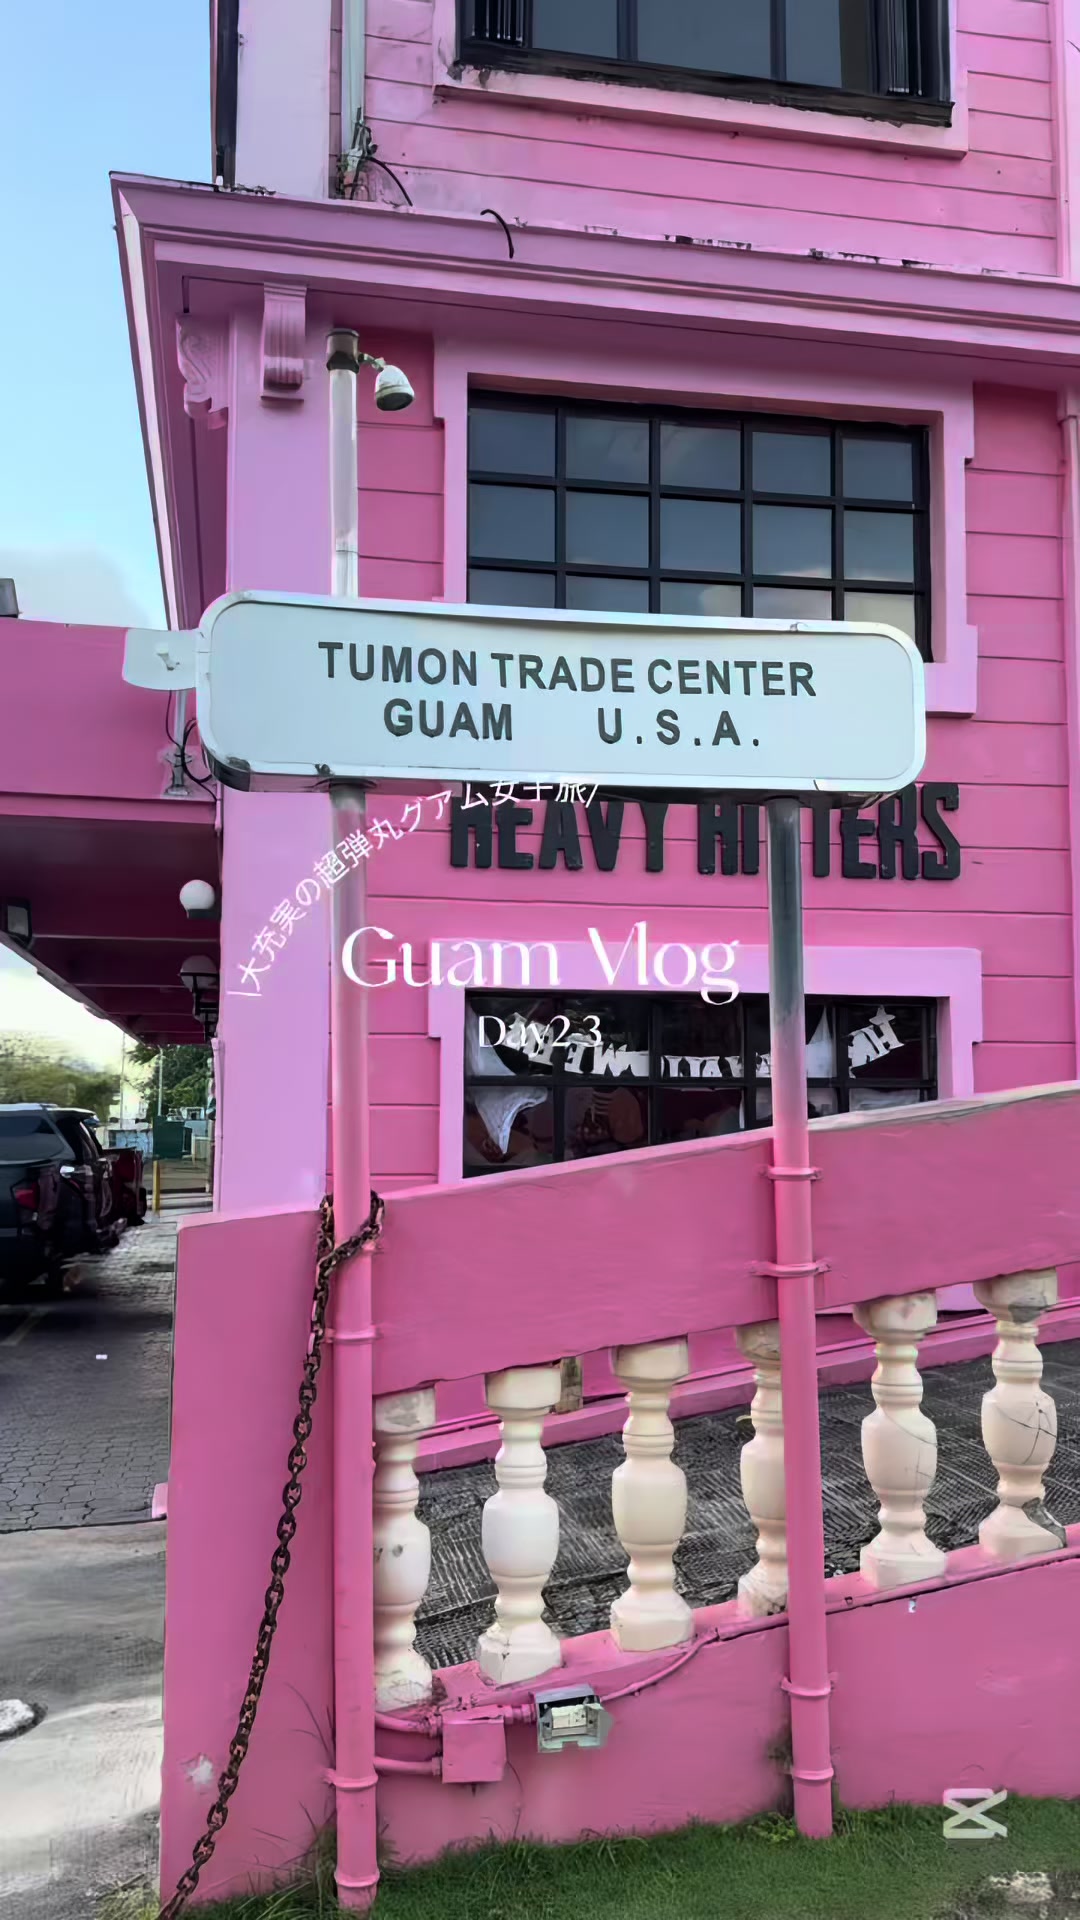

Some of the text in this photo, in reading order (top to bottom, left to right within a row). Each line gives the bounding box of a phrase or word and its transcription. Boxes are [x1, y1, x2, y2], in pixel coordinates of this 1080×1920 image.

[318, 641, 816, 696] TUMON TRADE CENTER
[384, 697, 760, 746] GUAM U.S.A.
[450, 783, 961, 880] HEAVY HITERS
